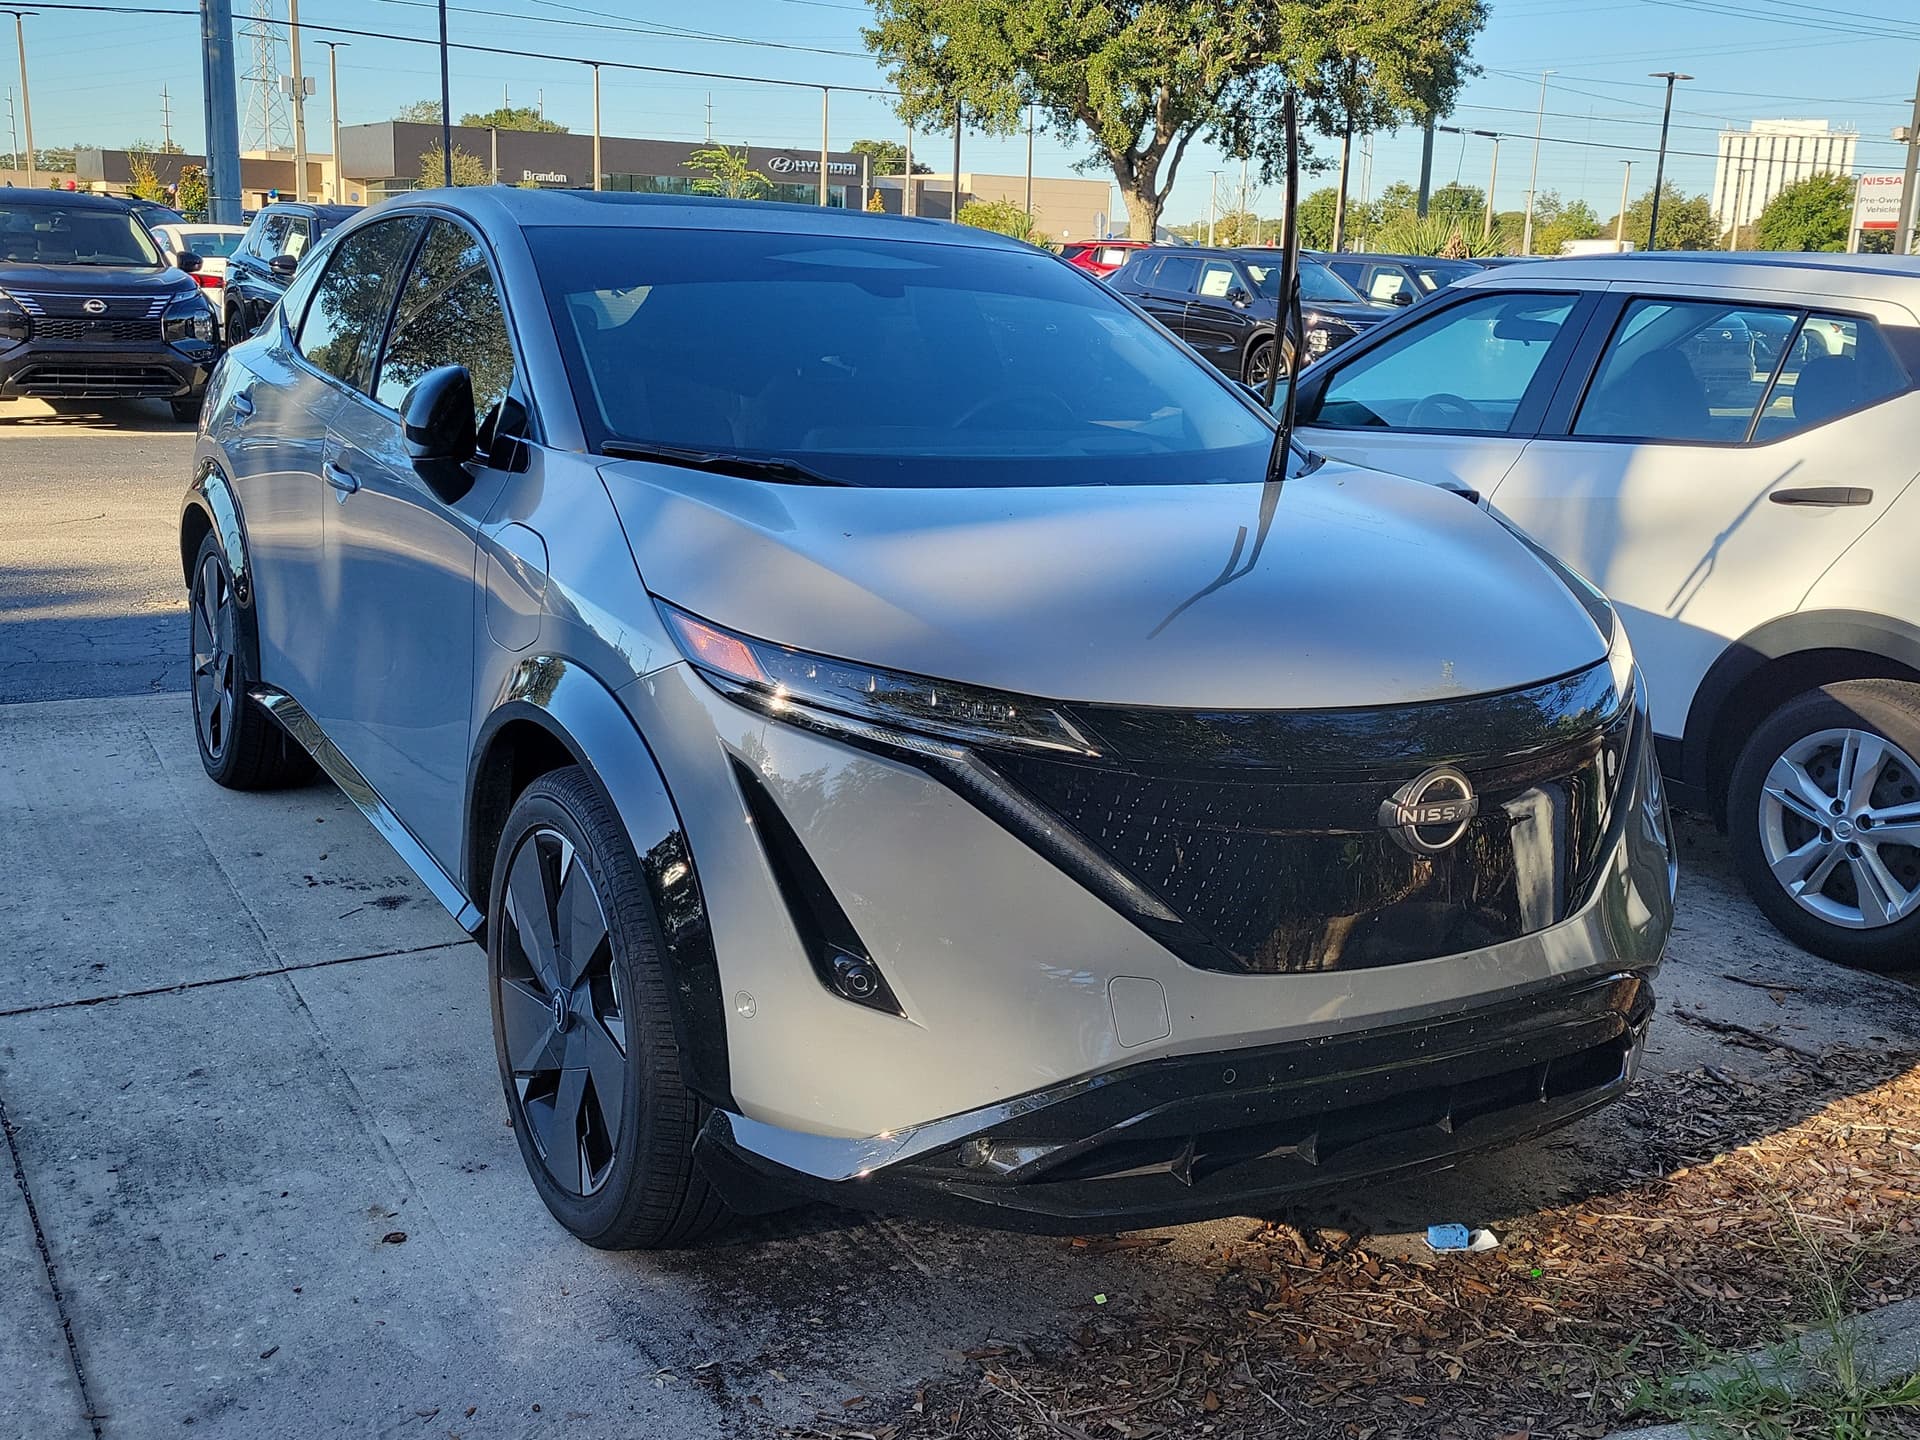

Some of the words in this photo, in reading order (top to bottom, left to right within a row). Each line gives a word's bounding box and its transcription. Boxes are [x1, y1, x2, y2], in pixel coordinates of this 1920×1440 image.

[523, 169, 567, 183] Brandon
[1862, 176, 1903, 186] NISSA
[1860, 196, 1902, 204] Pre-Own
[1401, 806, 1461, 823] NISS
